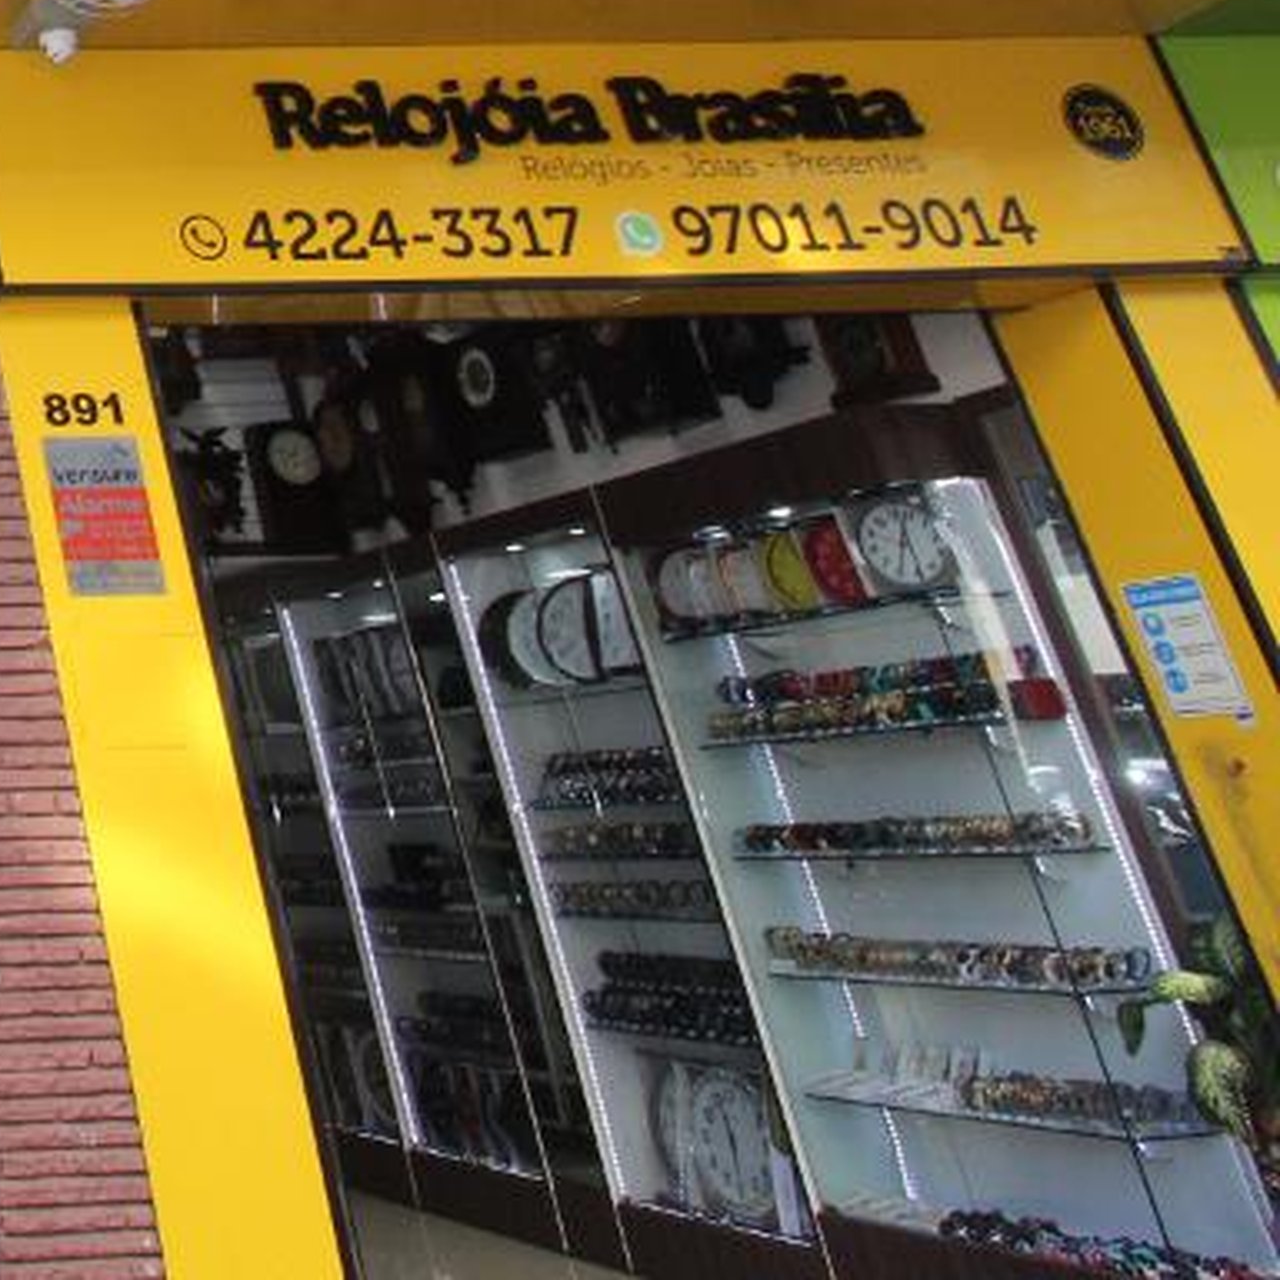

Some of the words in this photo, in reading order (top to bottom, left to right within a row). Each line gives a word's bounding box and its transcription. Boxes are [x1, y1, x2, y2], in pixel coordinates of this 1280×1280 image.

[253, 79, 610, 165] Relojóia
[520, 154, 652, 185] Relógios
[784, 150, 927, 176] Presentes
[242, 207, 579, 261] 4224-3317
[672, 197, 1038, 256] 97011-9014
[42, 392, 124, 426] 891
